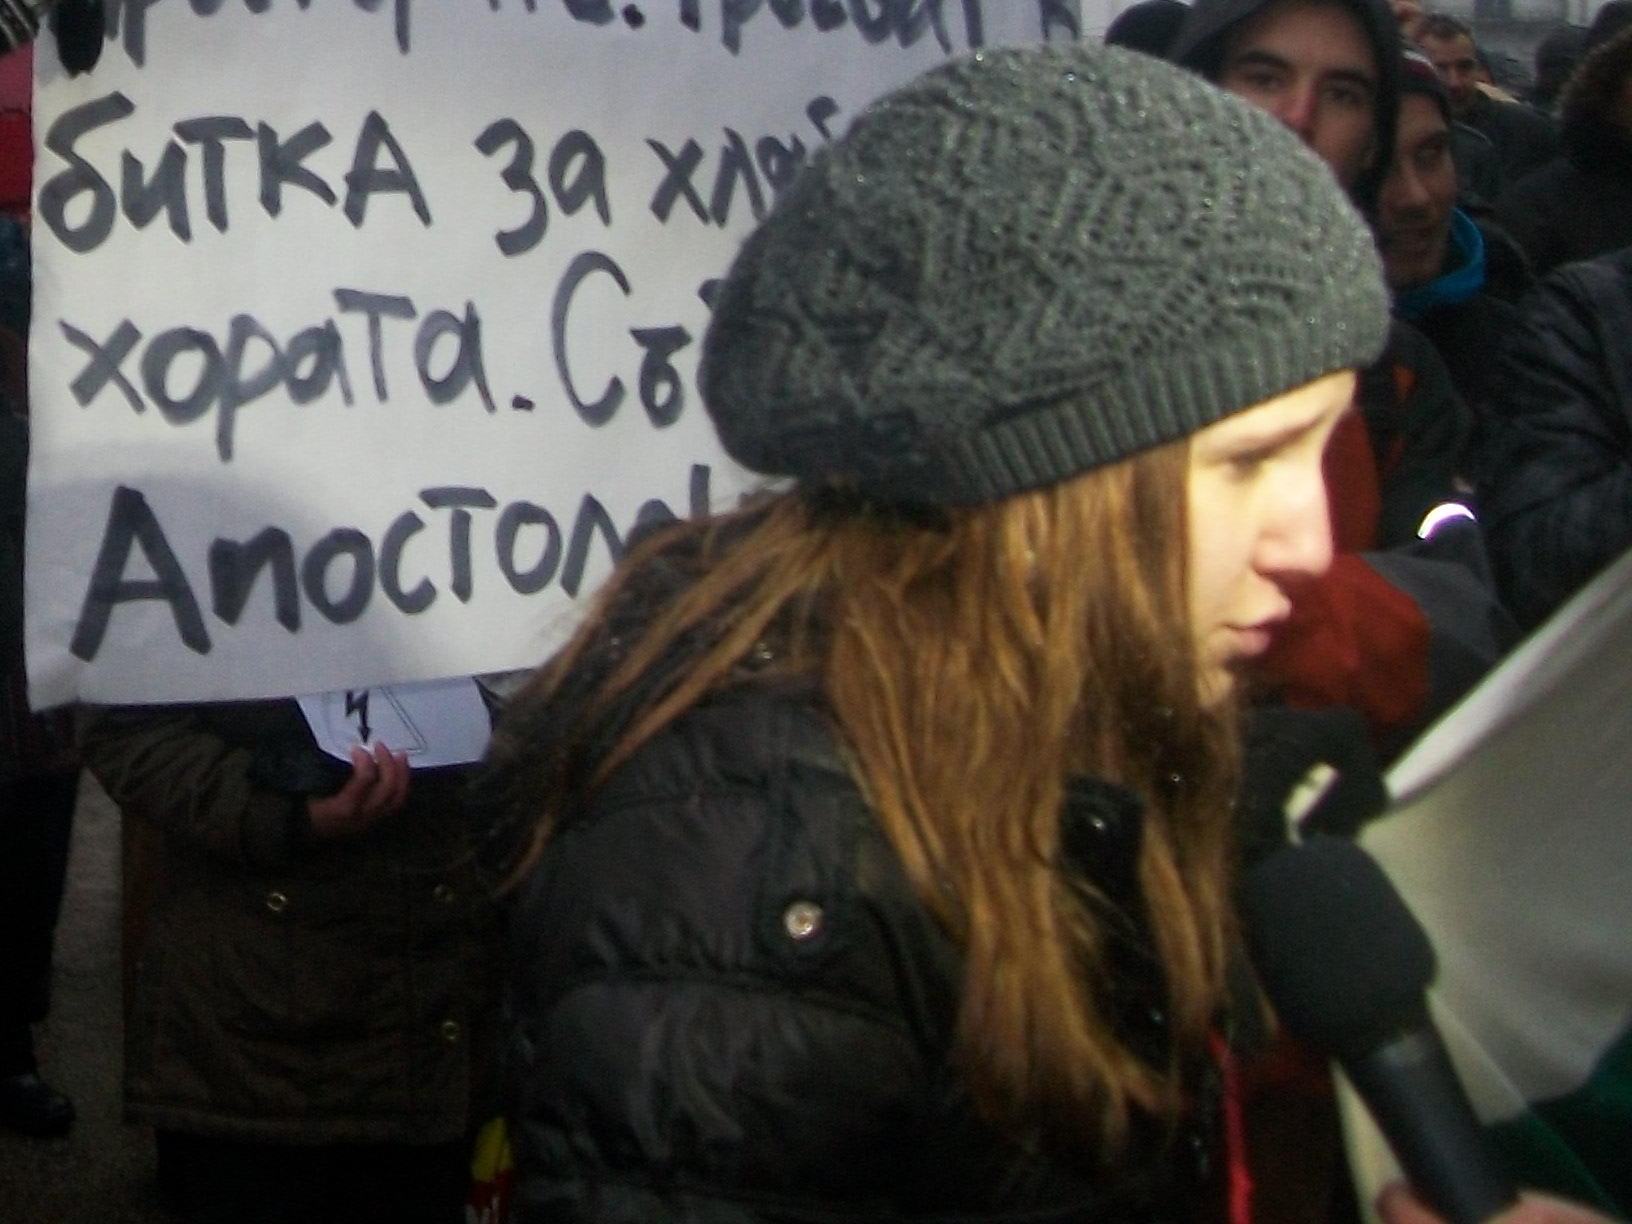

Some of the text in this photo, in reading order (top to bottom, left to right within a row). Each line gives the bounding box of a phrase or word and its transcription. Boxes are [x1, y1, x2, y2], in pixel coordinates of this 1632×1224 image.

[474, 117, 613, 256] за
[59, 250, 720, 462] хората. Съ
